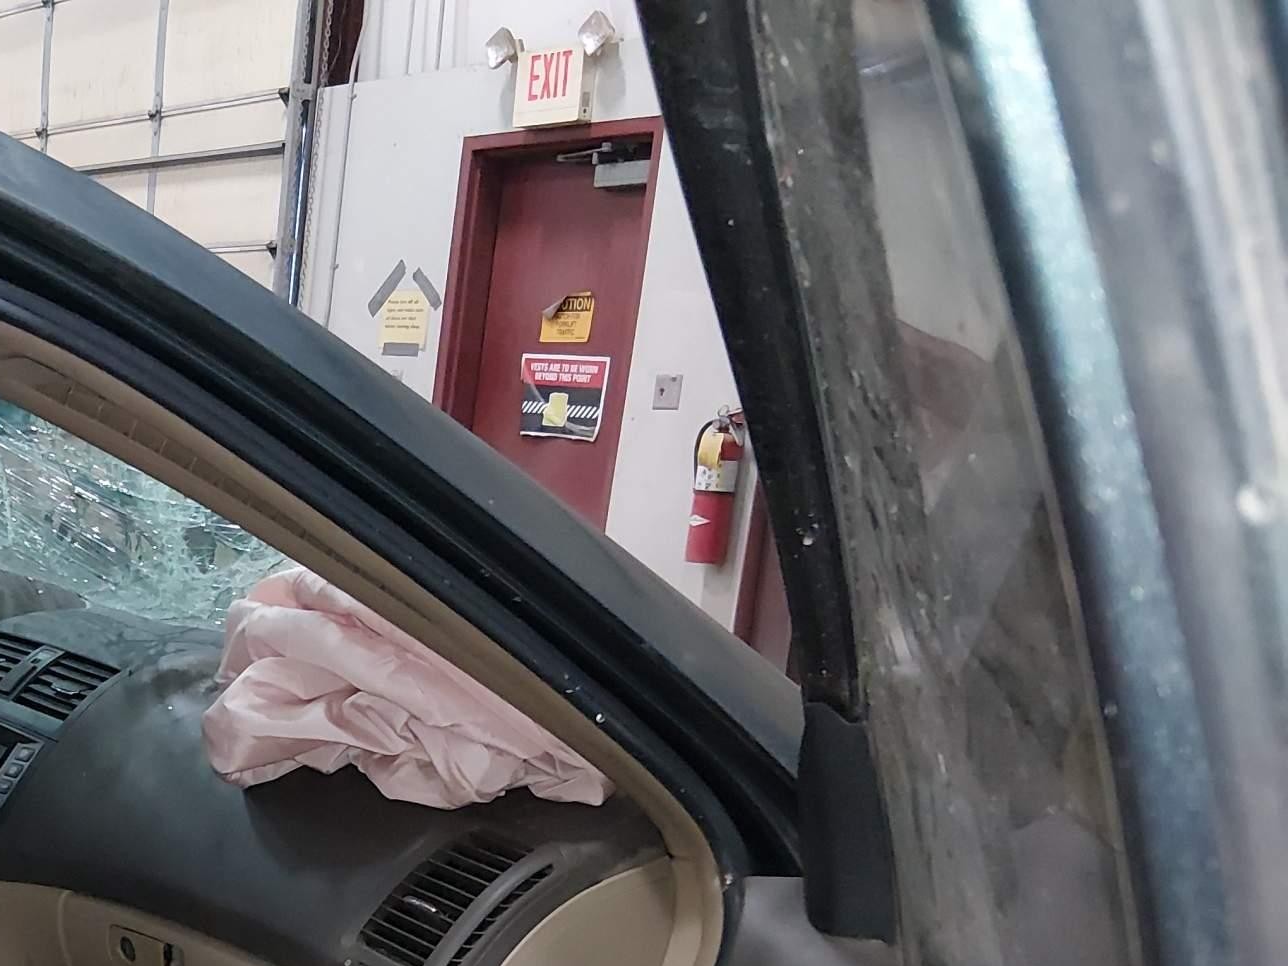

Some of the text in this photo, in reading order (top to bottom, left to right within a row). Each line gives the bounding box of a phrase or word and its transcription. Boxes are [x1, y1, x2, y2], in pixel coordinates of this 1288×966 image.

[528, 50, 573, 101] EXIT
[561, 297, 591, 311] UTION
[562, 363, 569, 373] TO
[559, 373, 572, 382] THIS
